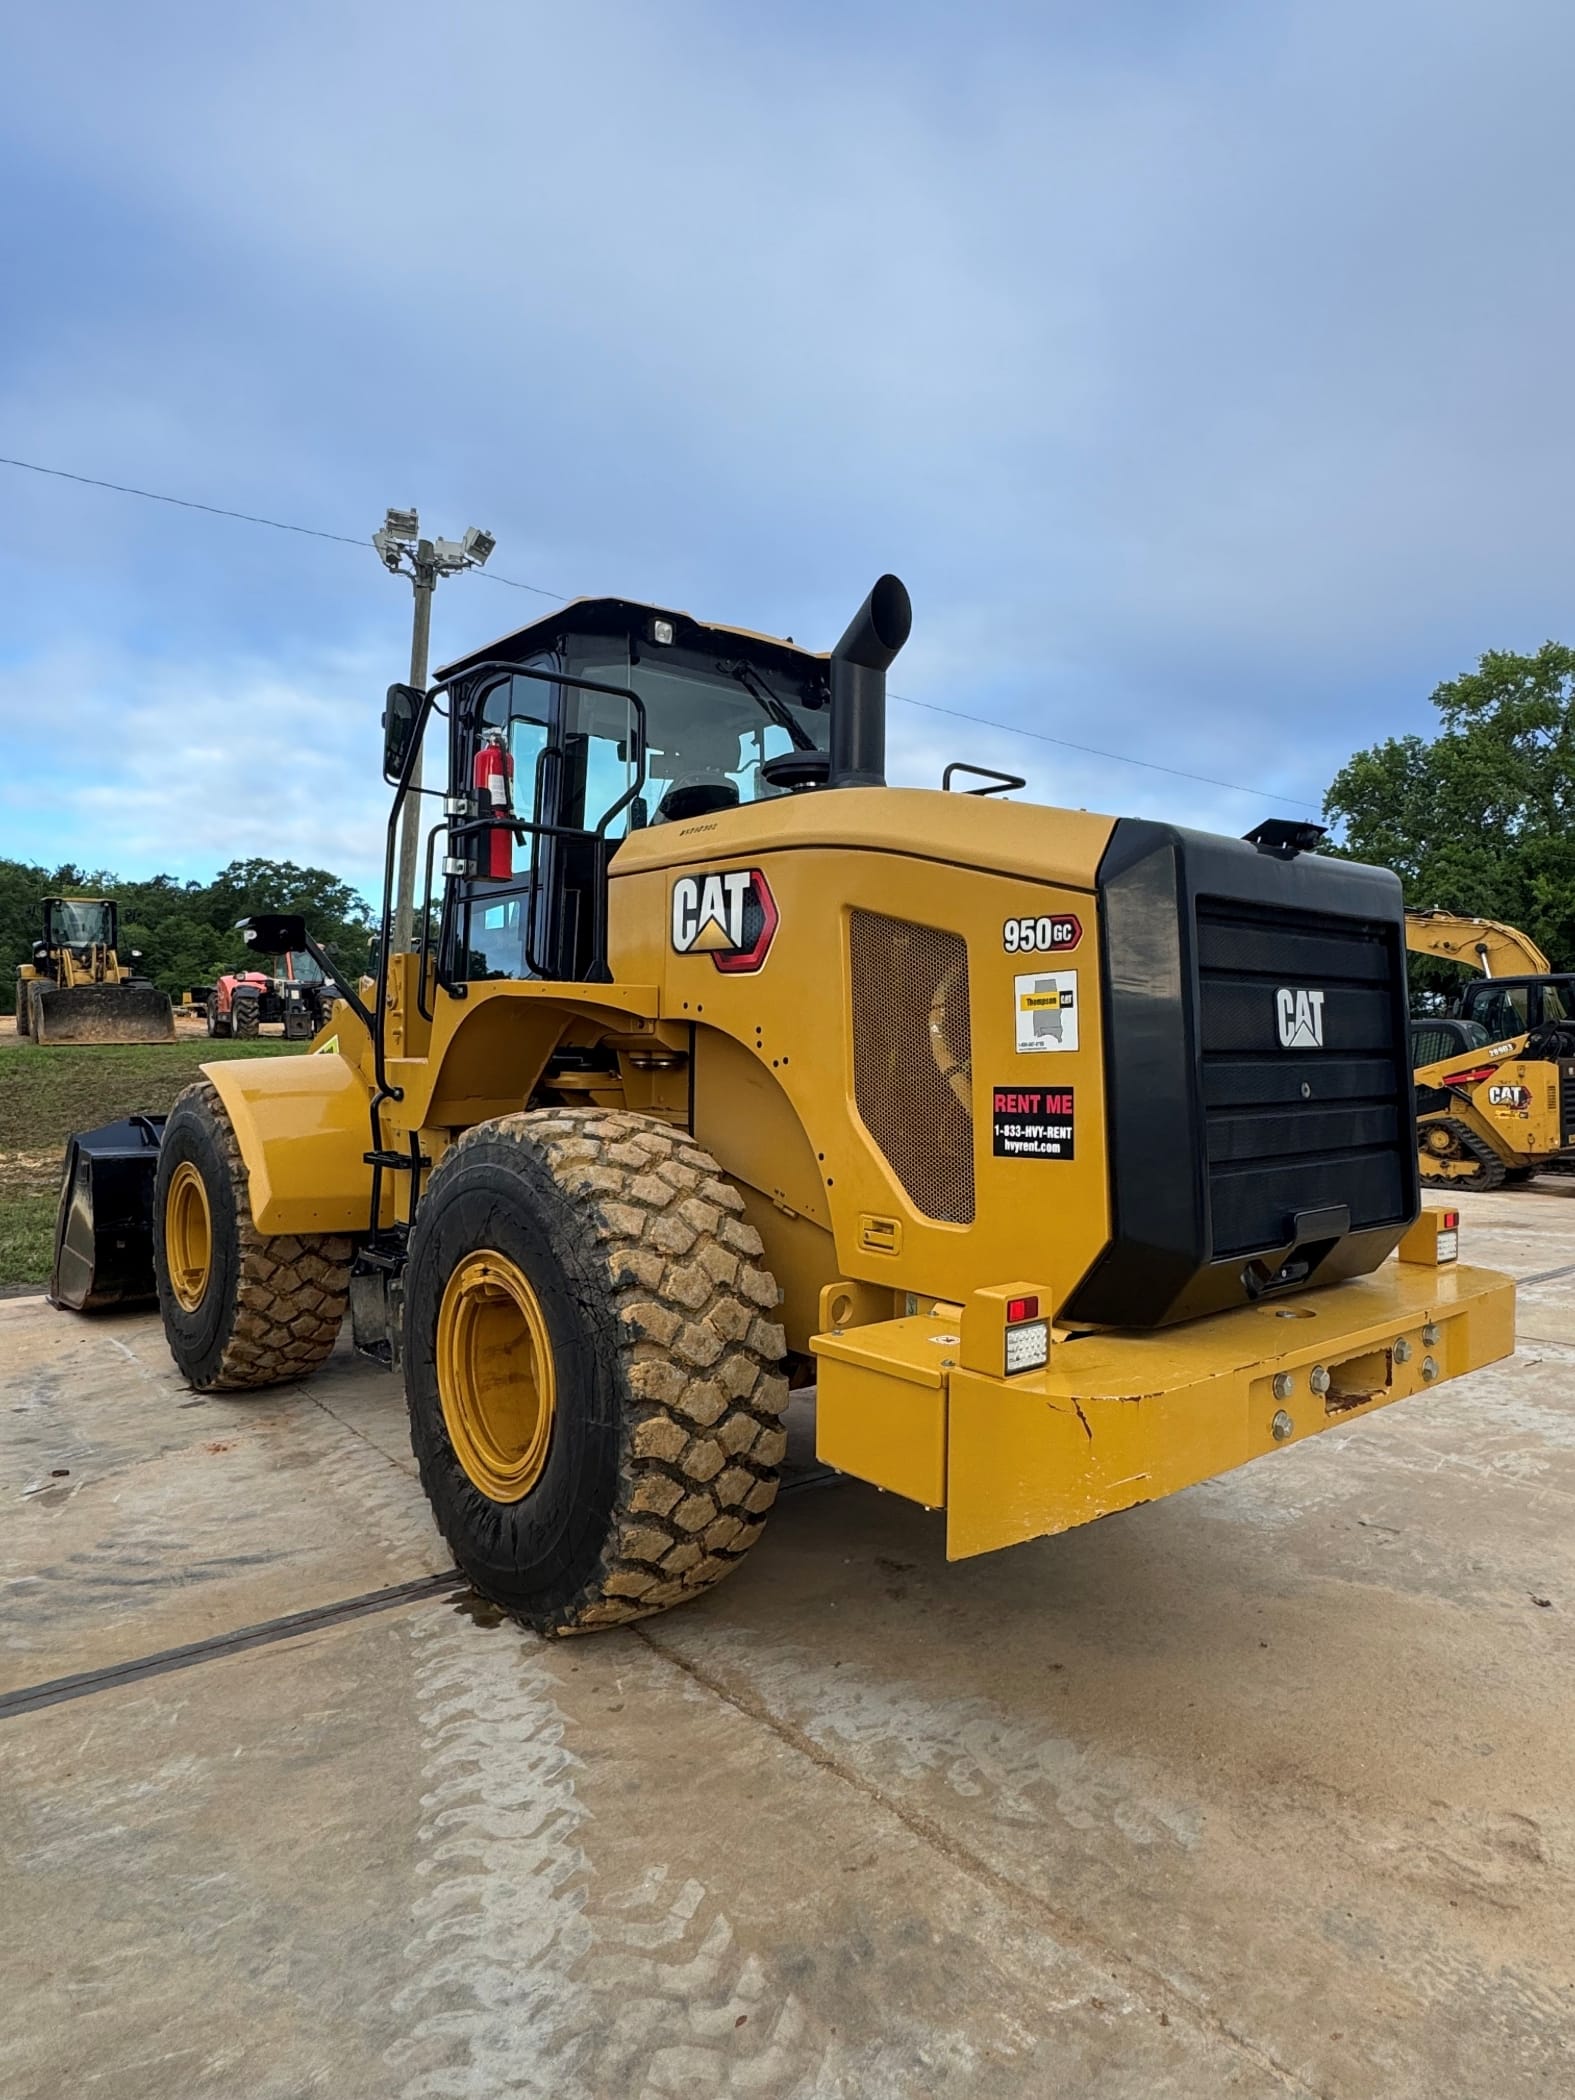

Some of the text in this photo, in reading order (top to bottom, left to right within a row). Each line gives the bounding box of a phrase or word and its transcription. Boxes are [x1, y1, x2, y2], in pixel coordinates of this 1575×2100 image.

[672, 871, 751, 952] CAT
[1276, 988, 1325, 1047] CAT
[994, 1094, 1073, 1115] RENT ME
[1489, 1086, 1522, 1106] CAT
[994, 1123, 1073, 1140] 1-833-HVY-RENT
[1004, 1138, 1061, 1154] hvyrent.com
